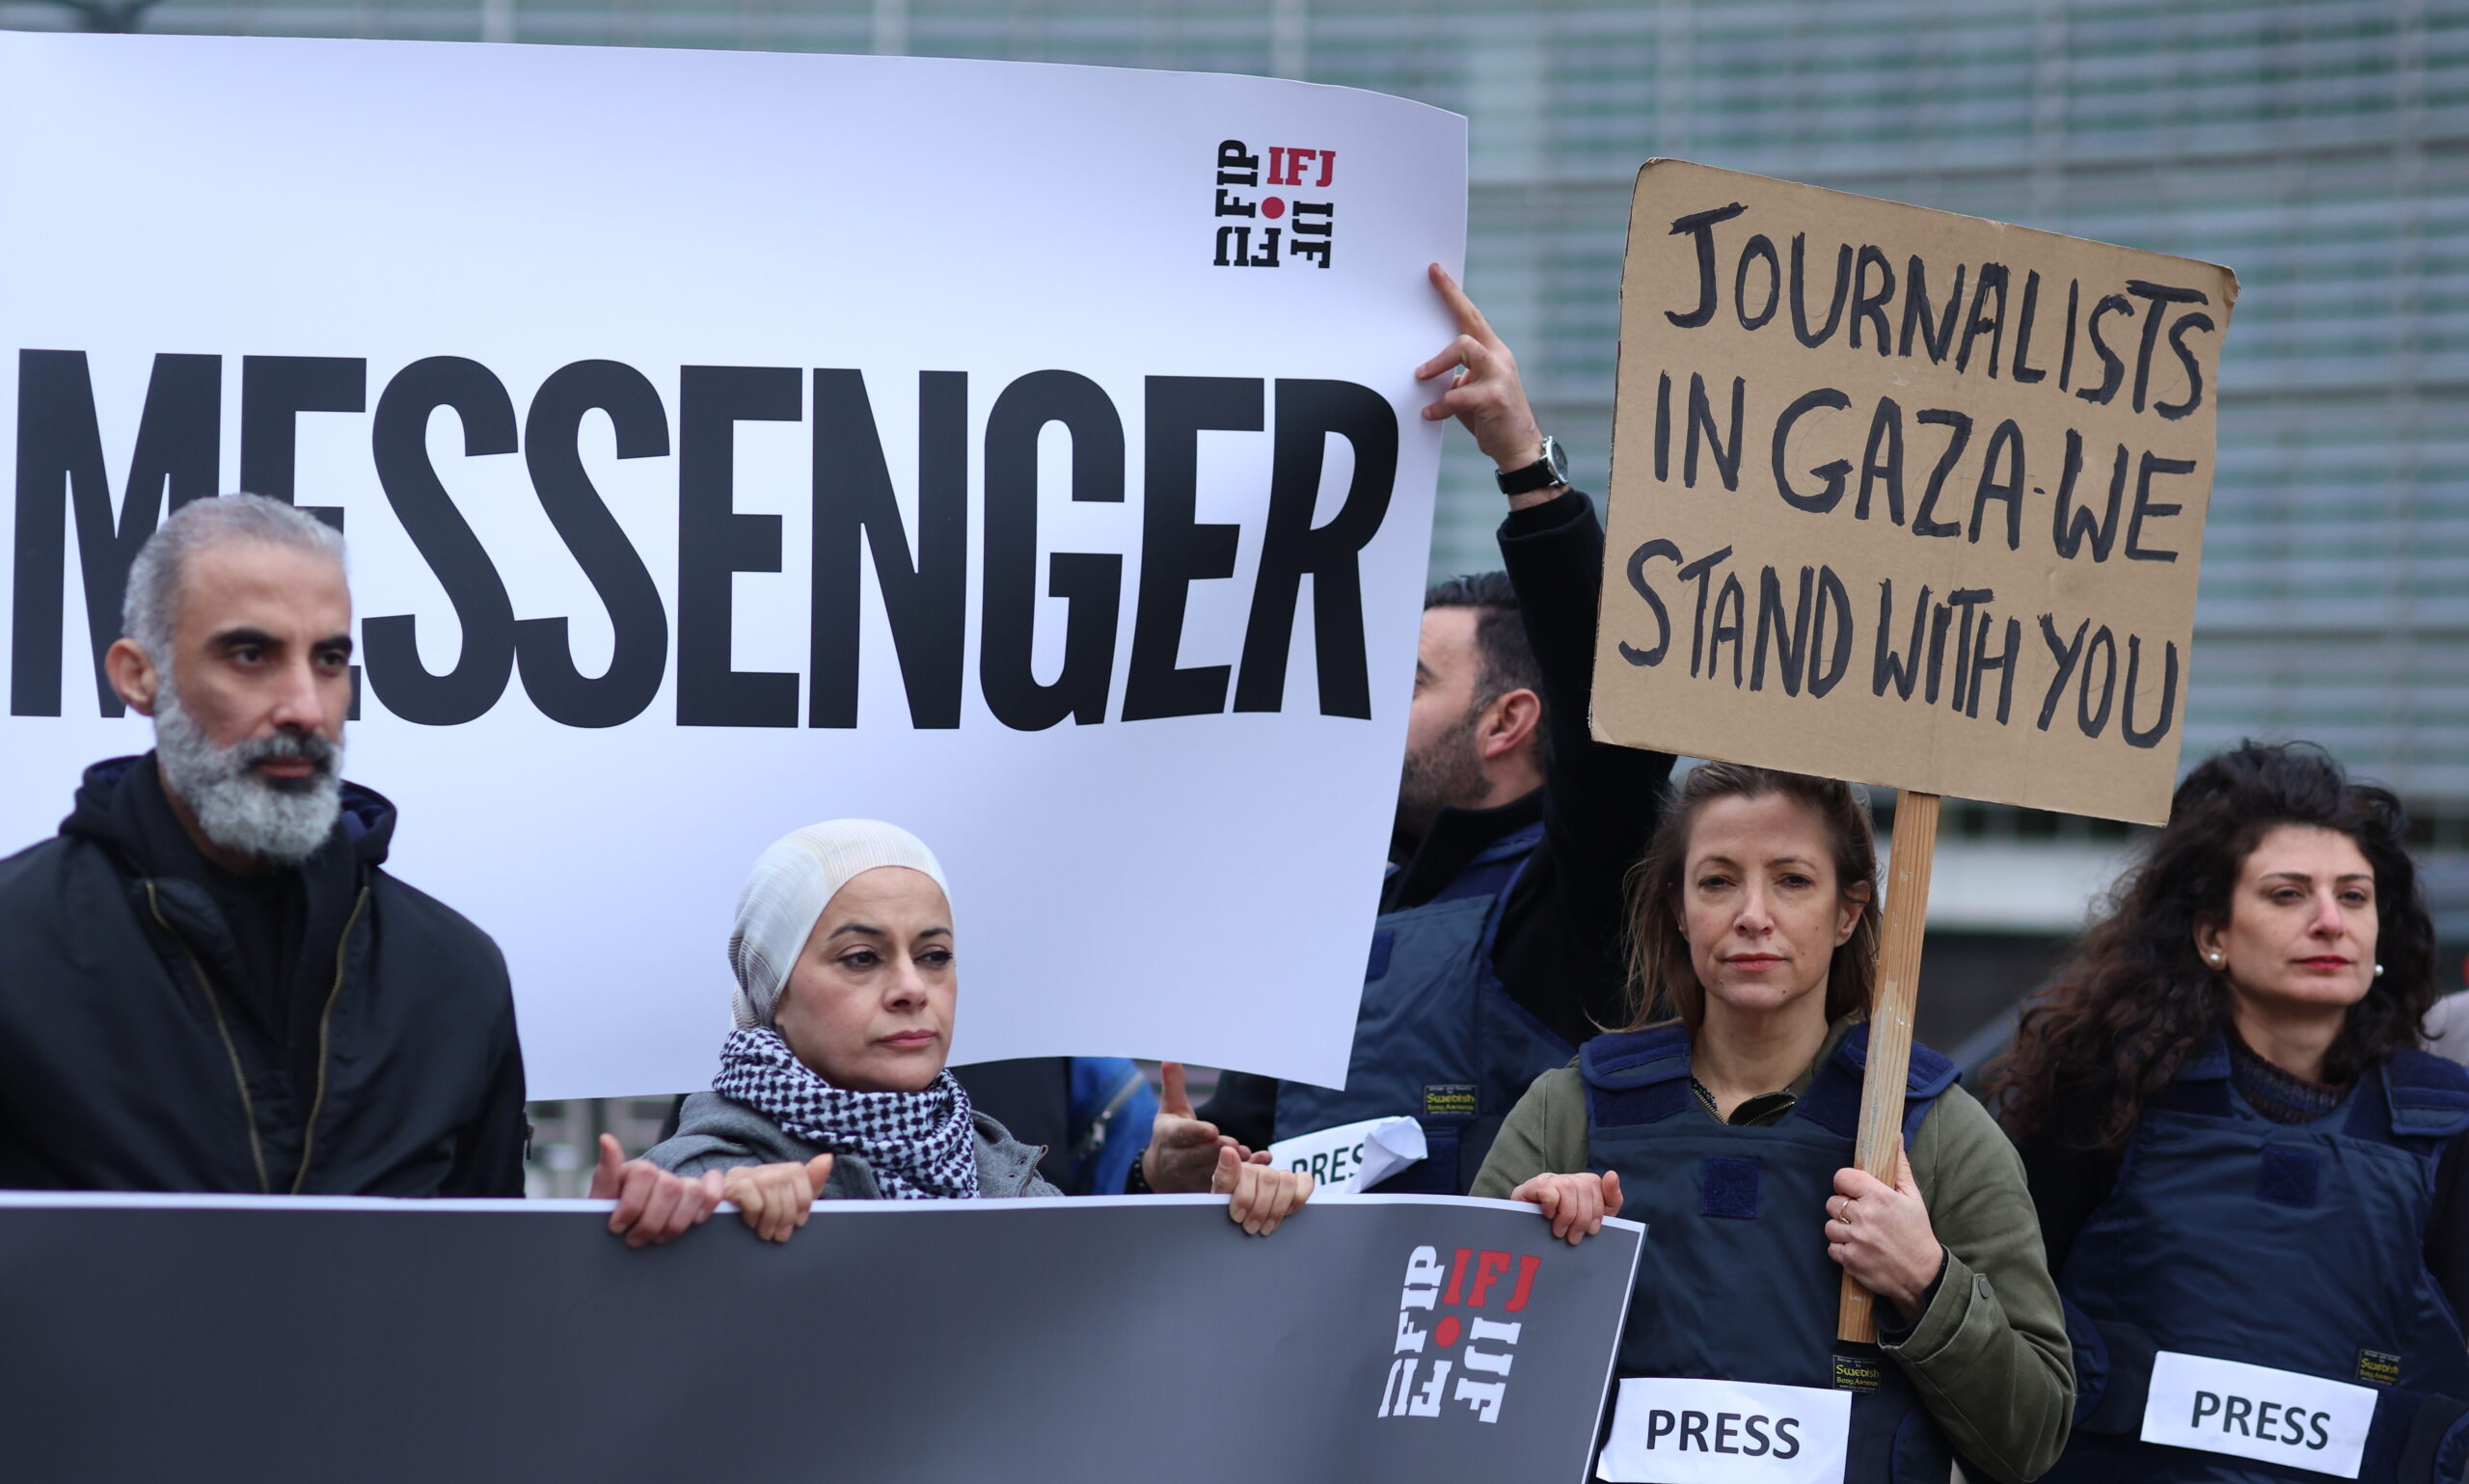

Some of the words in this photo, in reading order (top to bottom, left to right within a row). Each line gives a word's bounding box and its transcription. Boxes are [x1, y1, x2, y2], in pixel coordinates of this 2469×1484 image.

[1215, 140, 1259, 218] FIP
[1267, 147, 1336, 187] IFJ
[1664, 202, 2215, 421] JOURNALISTS
[1654, 369, 1746, 492] IN
[1618, 538, 1854, 700] STAND
[1872, 578, 2021, 726] WITH
[2036, 612, 2179, 749] YOU
[1394, 1245, 1445, 1355] FIP
[1442, 1248, 1542, 1312] IFJ
[1646, 1409, 1800, 1459] PRESS
[2190, 1390, 2331, 1450] PRESS
